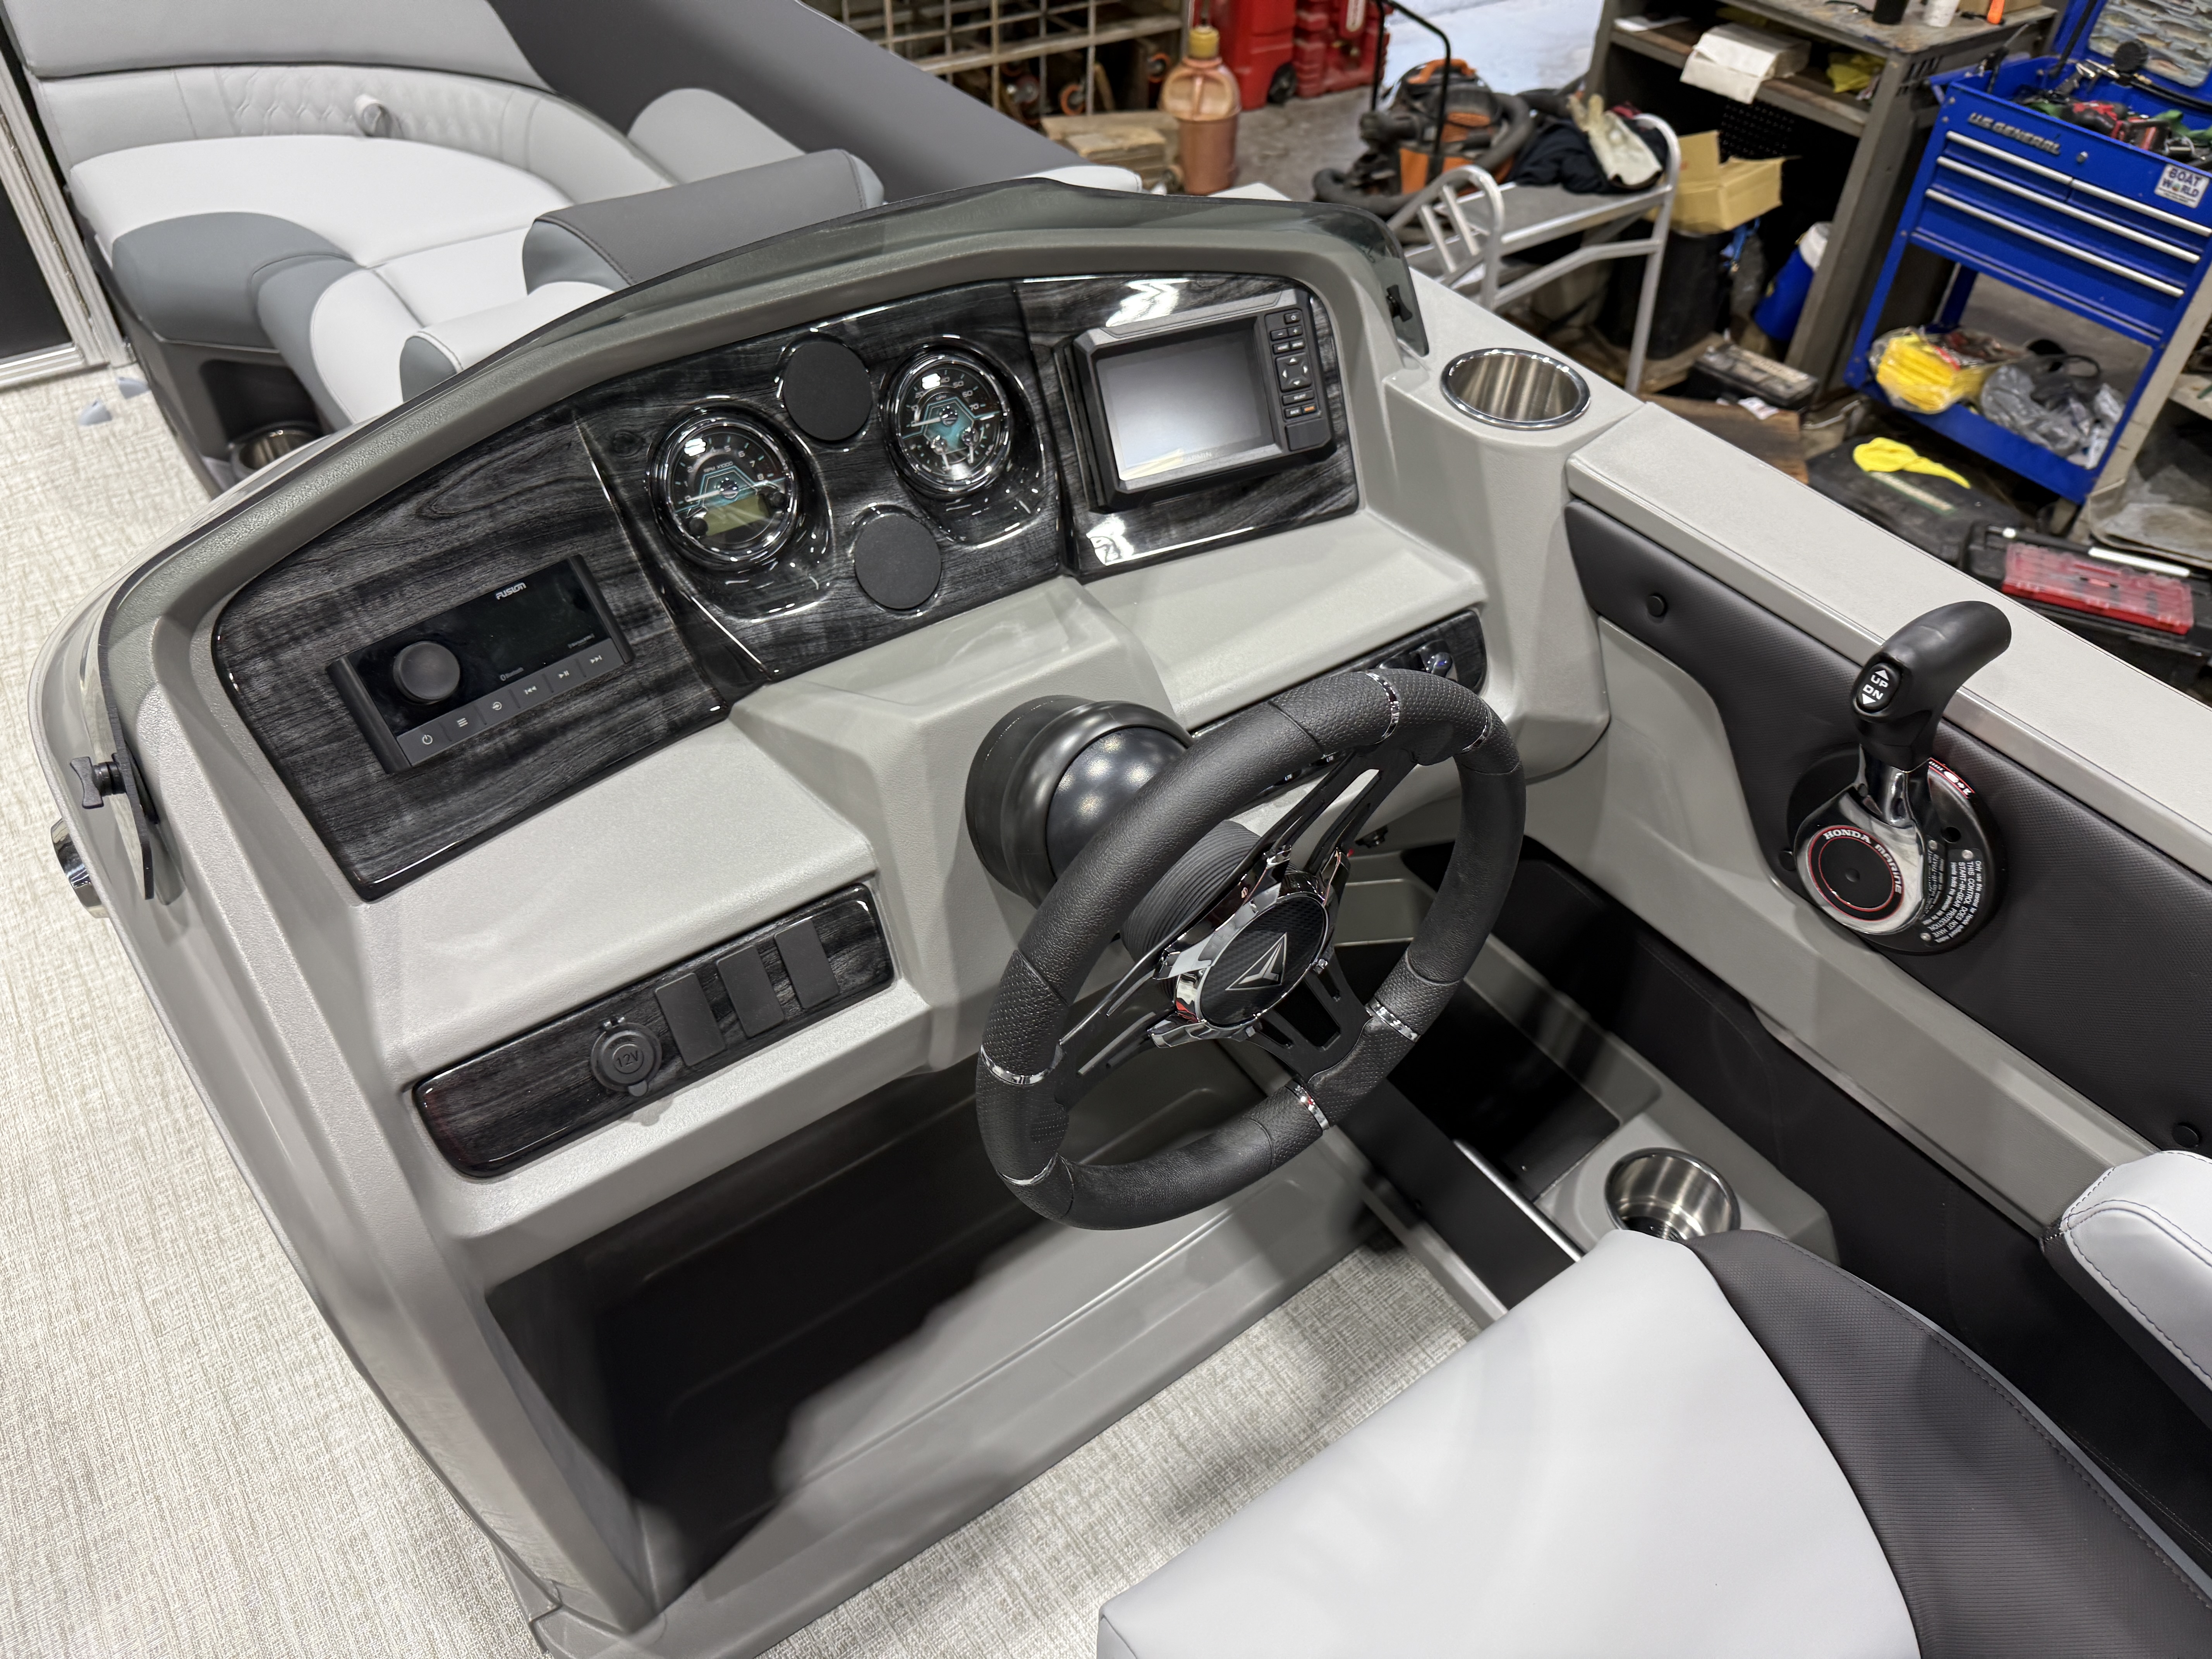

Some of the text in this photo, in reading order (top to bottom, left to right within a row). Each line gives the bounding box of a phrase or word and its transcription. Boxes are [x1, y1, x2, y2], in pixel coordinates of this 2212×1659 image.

[1992, 121, 2060, 155] GENERAL
[2169, 168, 2202, 187] BOAT
[962, 390, 973, 398] 60
[496, 582, 526, 600] FUSION
[1871, 675, 1888, 687] UP
[1863, 684, 1884, 699] DN
[1823, 829, 1871, 844] HONDA
[1953, 862, 1966, 908] START-IN-GEAR
[1963, 878, 1975, 904] CONTROL
[1973, 893, 1981, 907] control
[1955, 907, 1968, 921] DOES
[1948, 920, 1958, 930] NOT
[1932, 929, 1948, 938] HAVE
[616, 1050, 639, 1067] 12V
